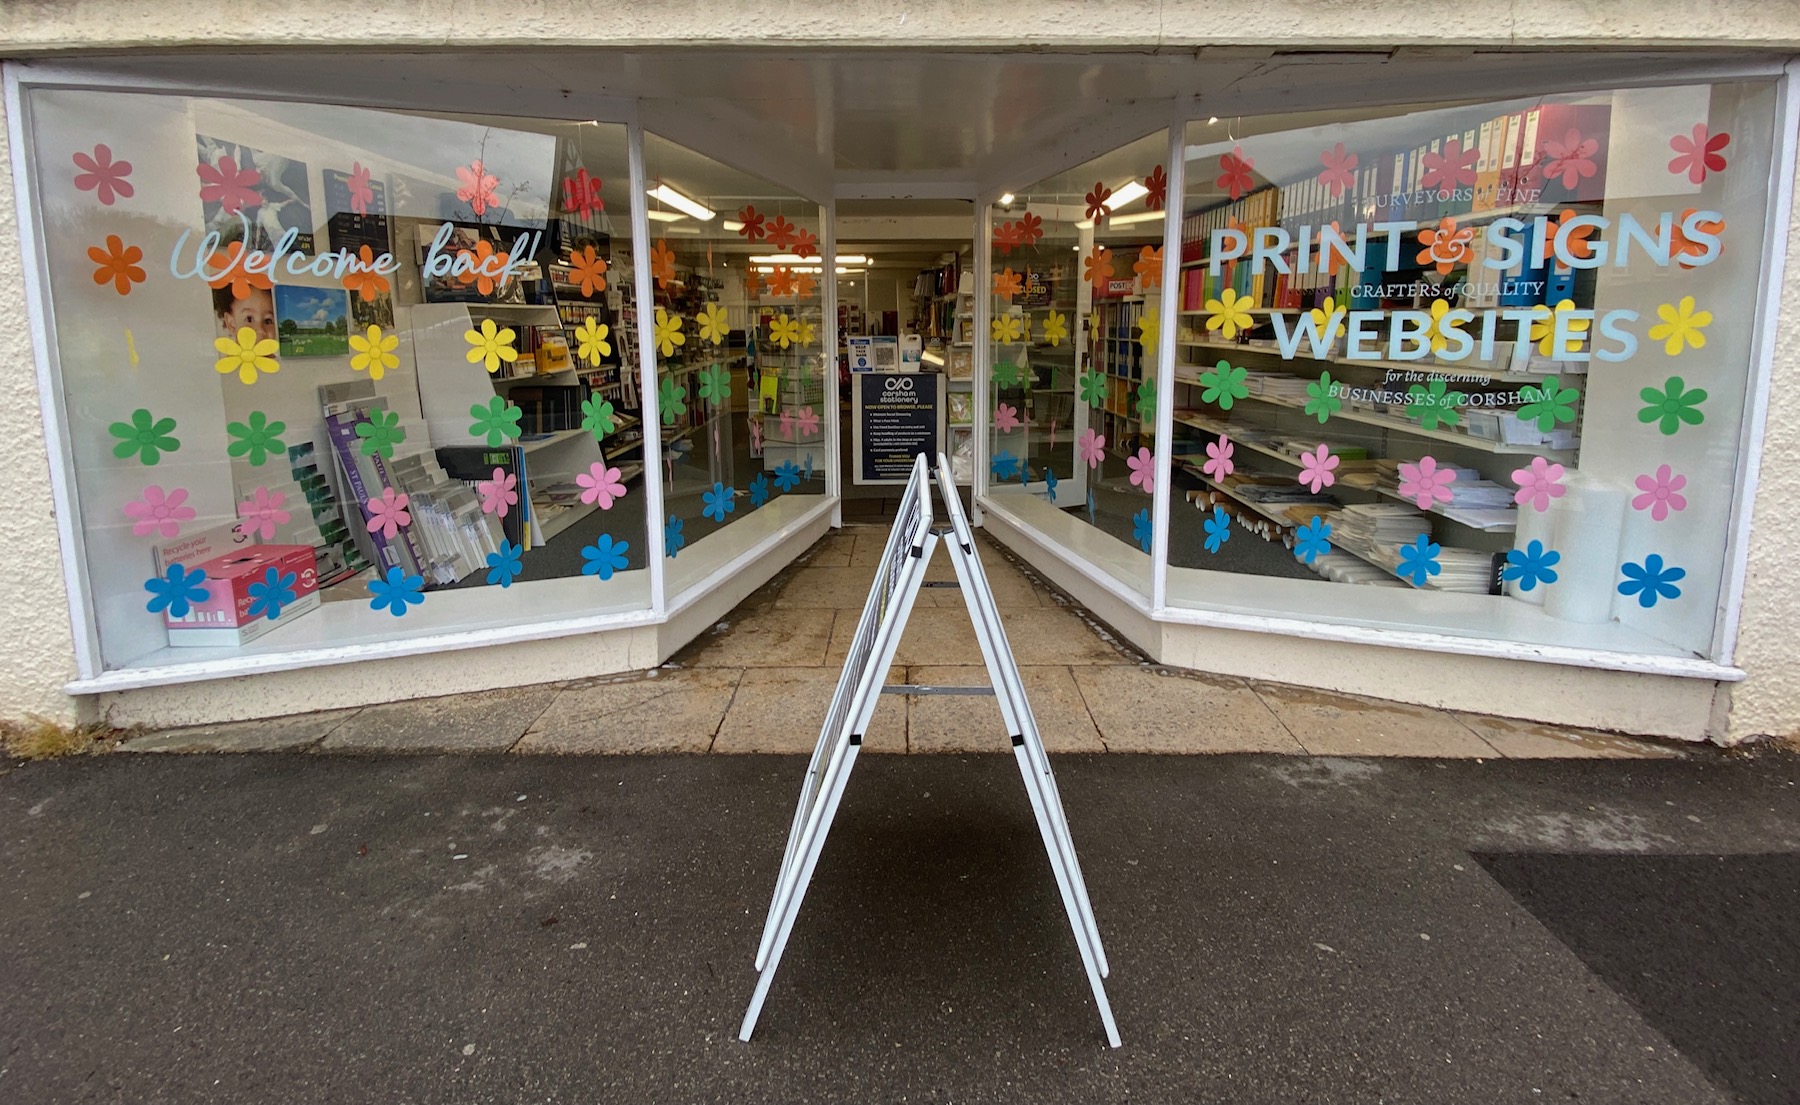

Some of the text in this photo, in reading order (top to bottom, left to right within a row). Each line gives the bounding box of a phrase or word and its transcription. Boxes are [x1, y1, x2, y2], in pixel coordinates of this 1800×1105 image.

[1495, 189, 1541, 203] FINE
[170, 208, 402, 283] Welcome
[423, 221, 542, 288] back!
[1209, 210, 1725, 276] PRINT & SIGNS
[1350, 281, 1545, 300] CRAFTERS of QUALITY
[1269, 310, 1641, 362] WEBSITES
[1383, 369, 1492, 386] for the discerning
[880, 396, 919, 405] stationery
[1327, 385, 1552, 410] BUSINESSES of CORSHAM
[163, 536, 207, 556] Recycle your
[196, 546, 212, 557] here
